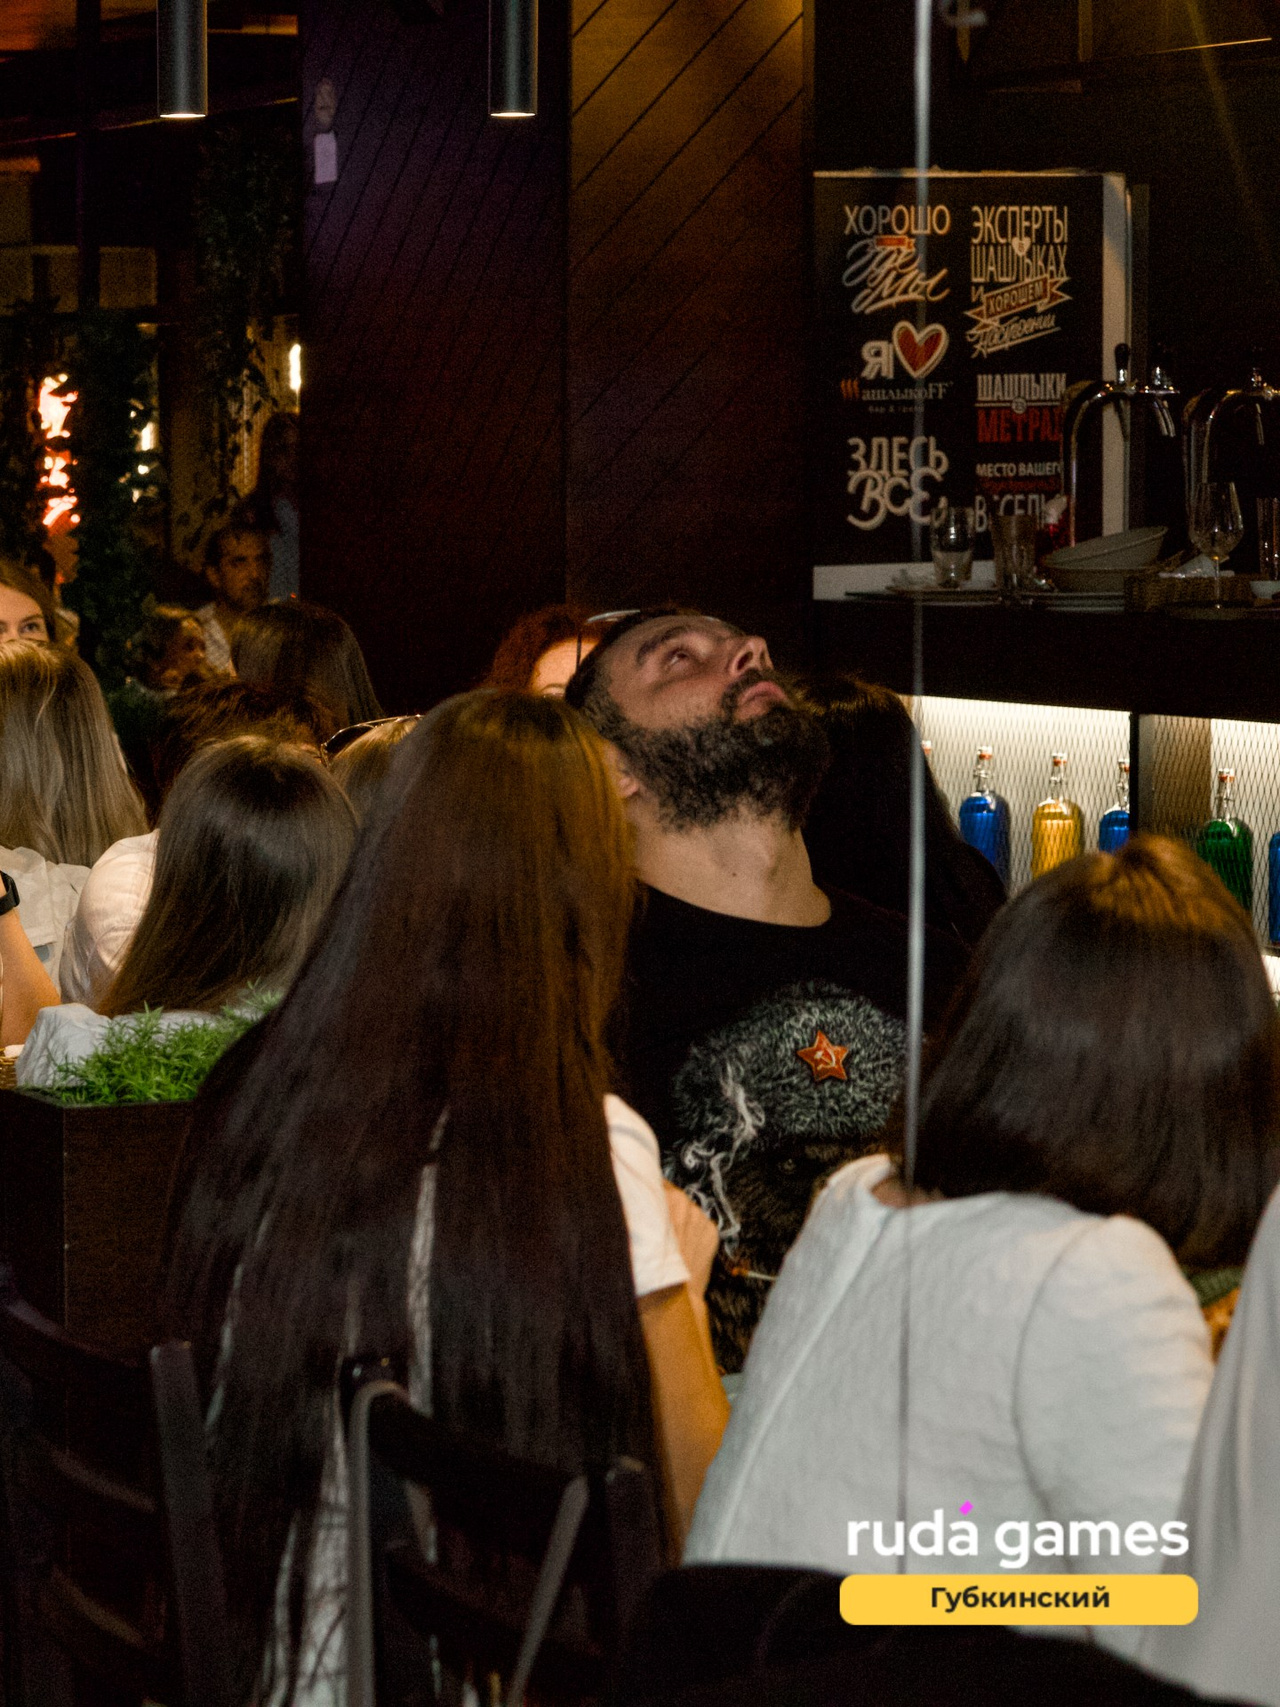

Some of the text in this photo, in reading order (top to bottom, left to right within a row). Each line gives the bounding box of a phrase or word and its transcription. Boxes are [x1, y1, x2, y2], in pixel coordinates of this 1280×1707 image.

[843, 205, 951, 235] ХОРОШО
[971, 205, 1068, 244] ЭКСПЕРТЫ
[970, 244, 1068, 282] ШАШЛЫКАХ
[988, 281, 1045, 315] ХОРОШЕМ
[861, 340, 895, 380] Я
[976, 373, 1067, 400] ШАШЛЫКИ
[847, 436, 949, 478] ЗДЕСЬ
[975, 462, 1017, 477] МЕСТО
